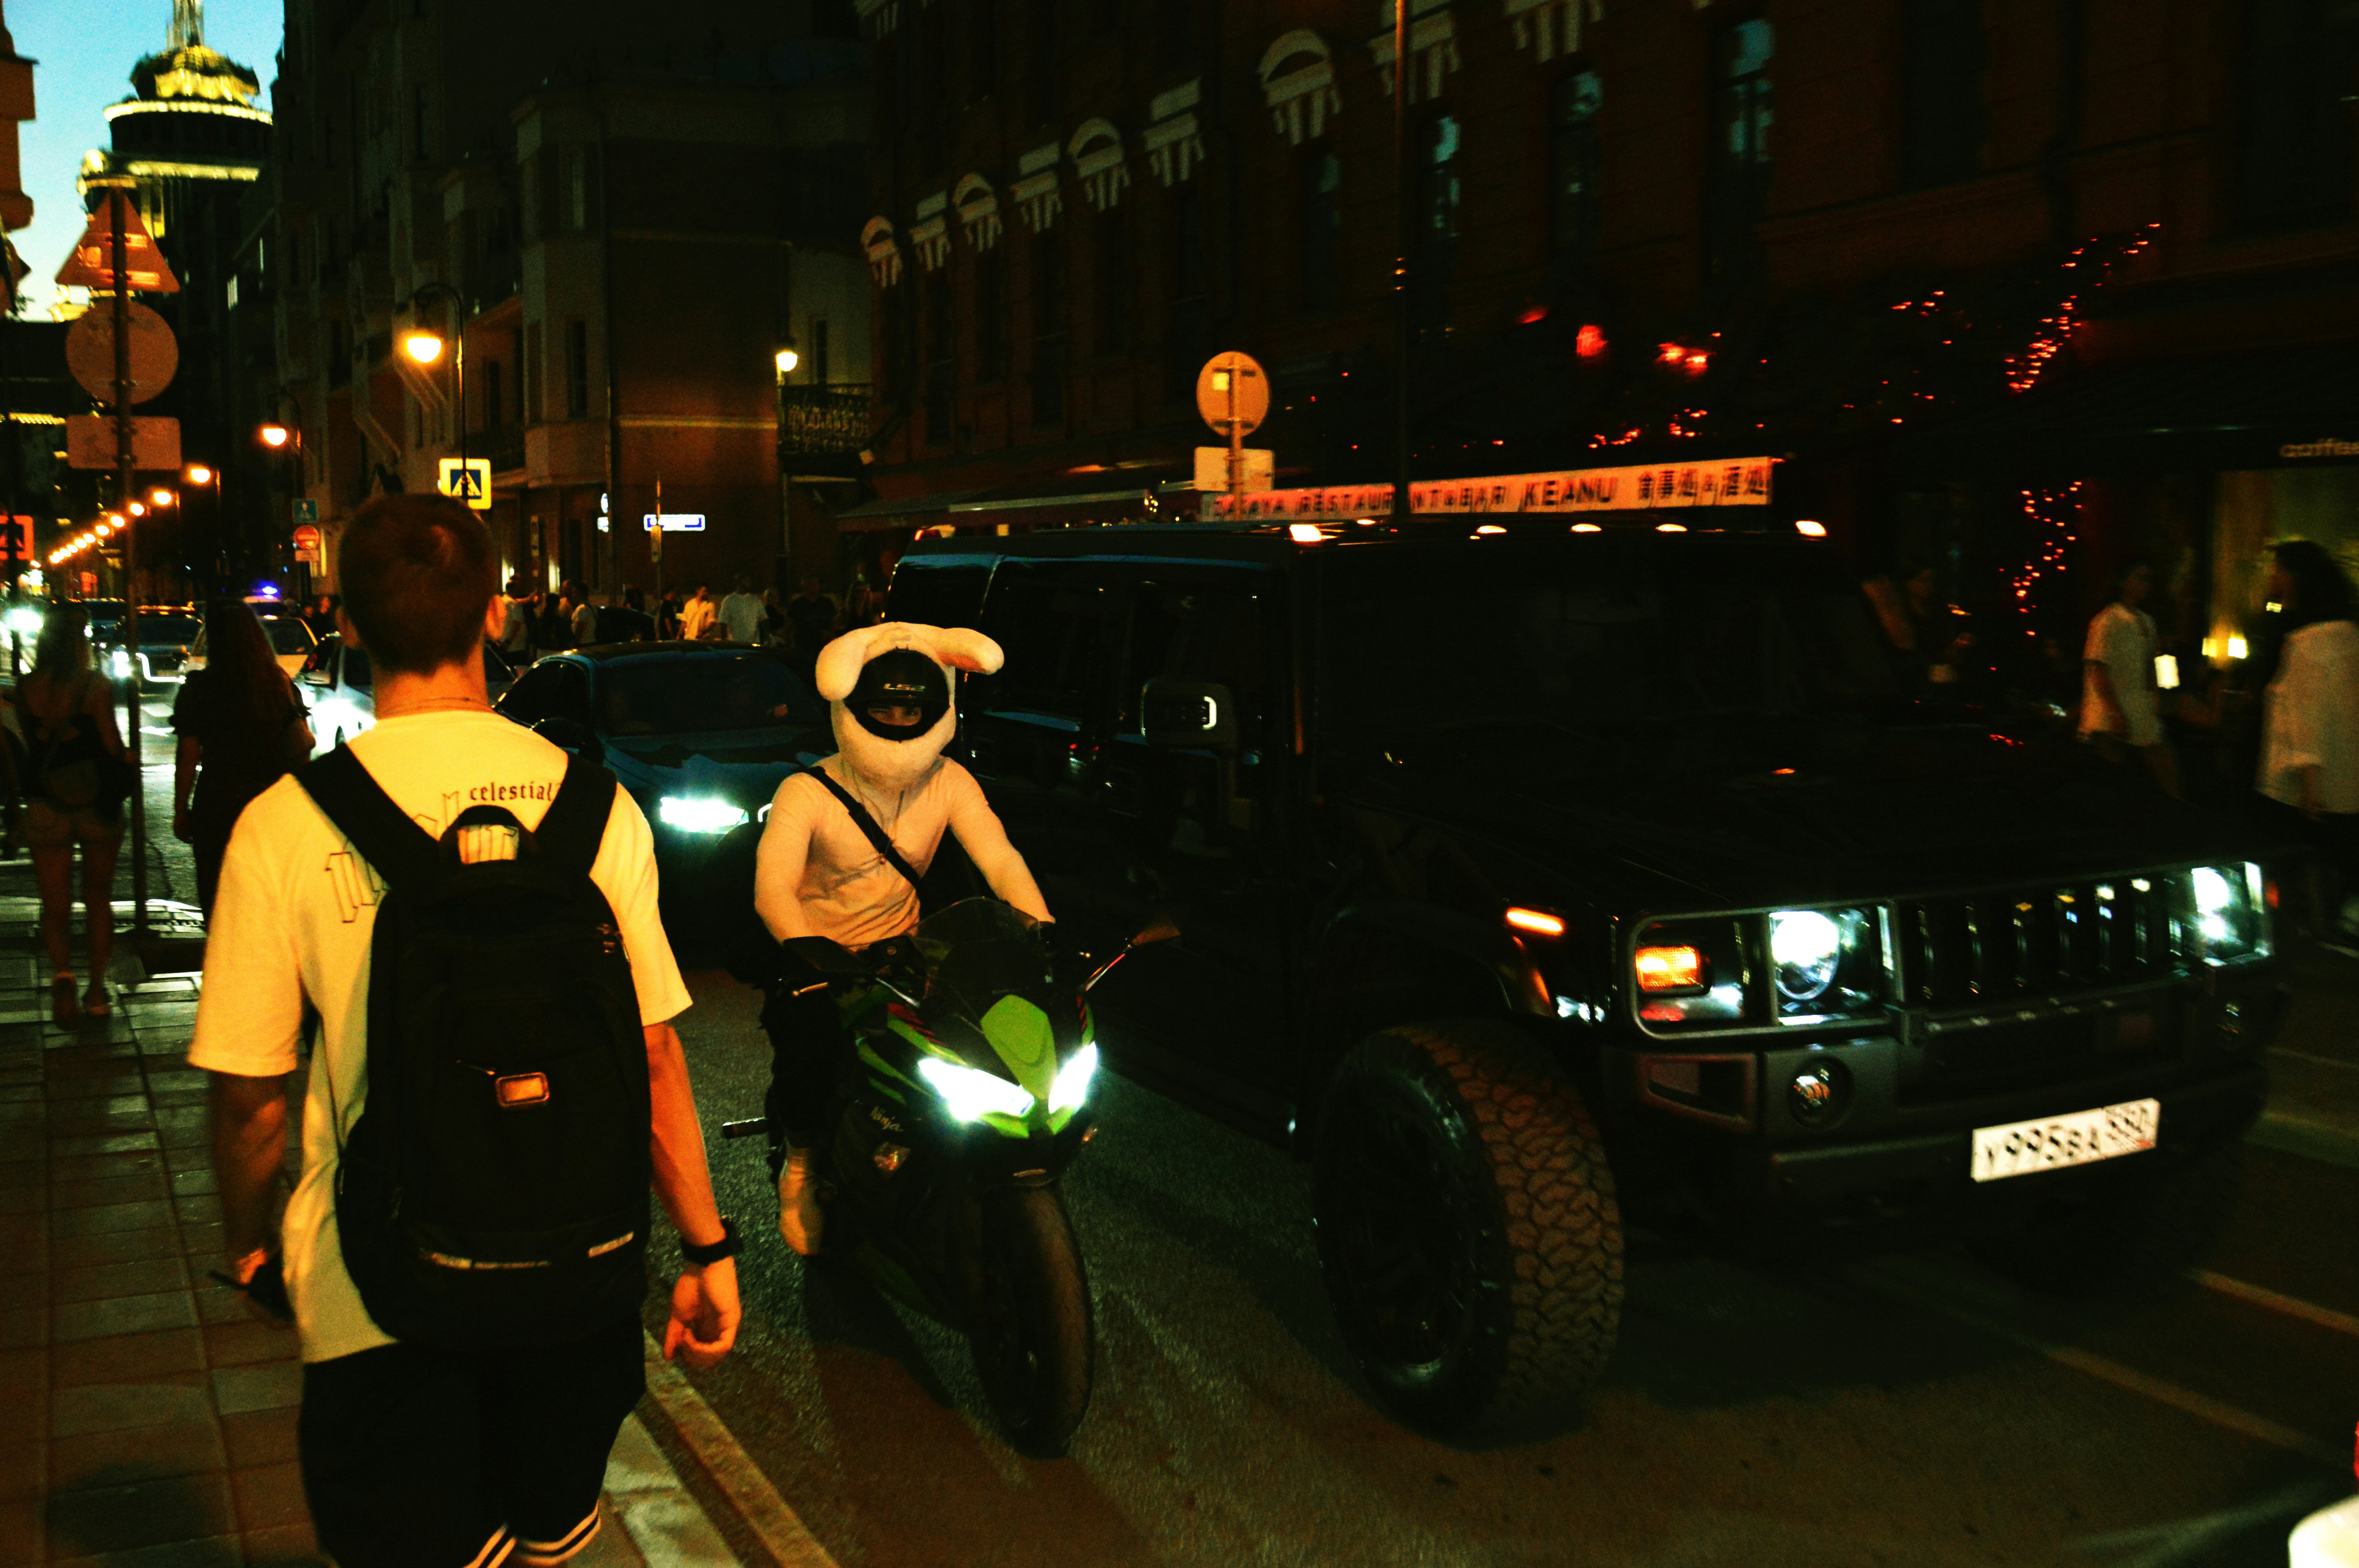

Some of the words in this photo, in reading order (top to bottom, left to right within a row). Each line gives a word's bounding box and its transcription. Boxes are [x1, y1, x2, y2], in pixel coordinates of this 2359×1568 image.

[1521, 477, 1618, 508] KEANU
[470, 781, 552, 801] celestial
[870, 1106, 904, 1132] Ninja
